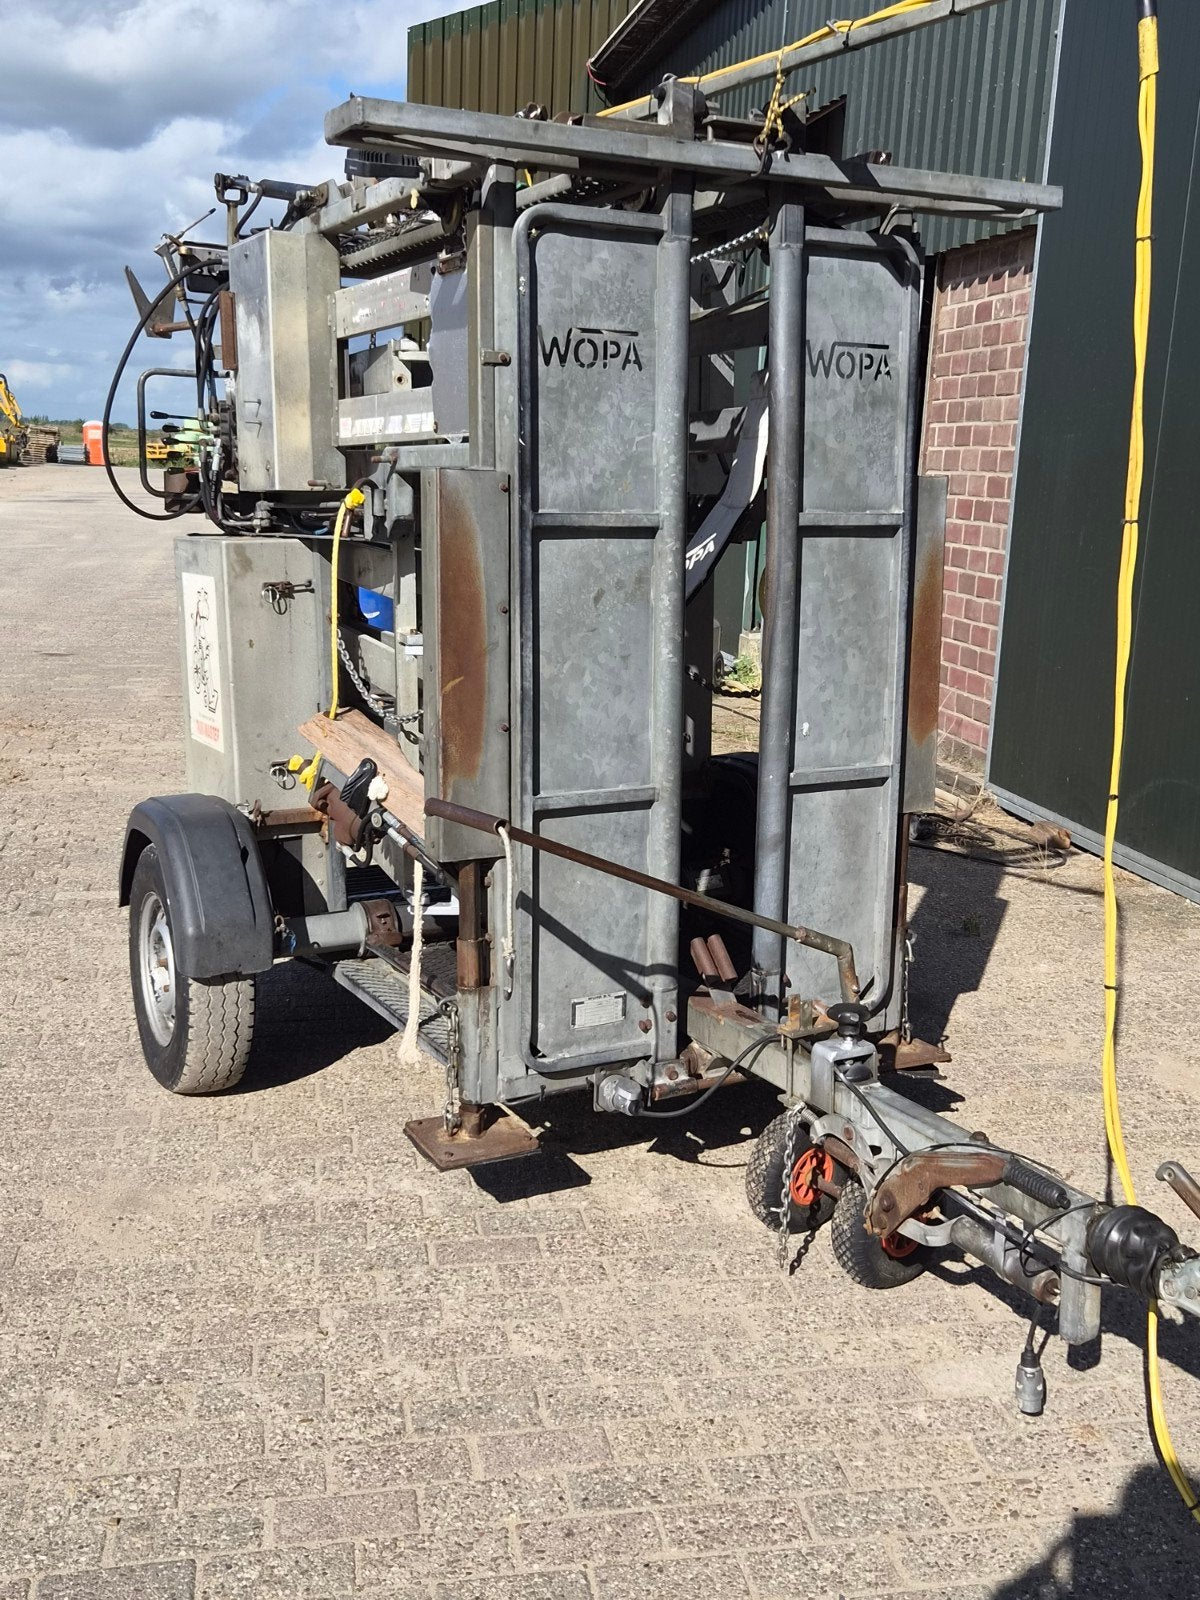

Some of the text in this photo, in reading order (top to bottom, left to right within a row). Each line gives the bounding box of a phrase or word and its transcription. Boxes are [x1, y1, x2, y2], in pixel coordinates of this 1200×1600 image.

[537, 325, 643, 372] WOPA
[806, 340, 892, 381] WOPA
[685, 533, 716, 570] PA
